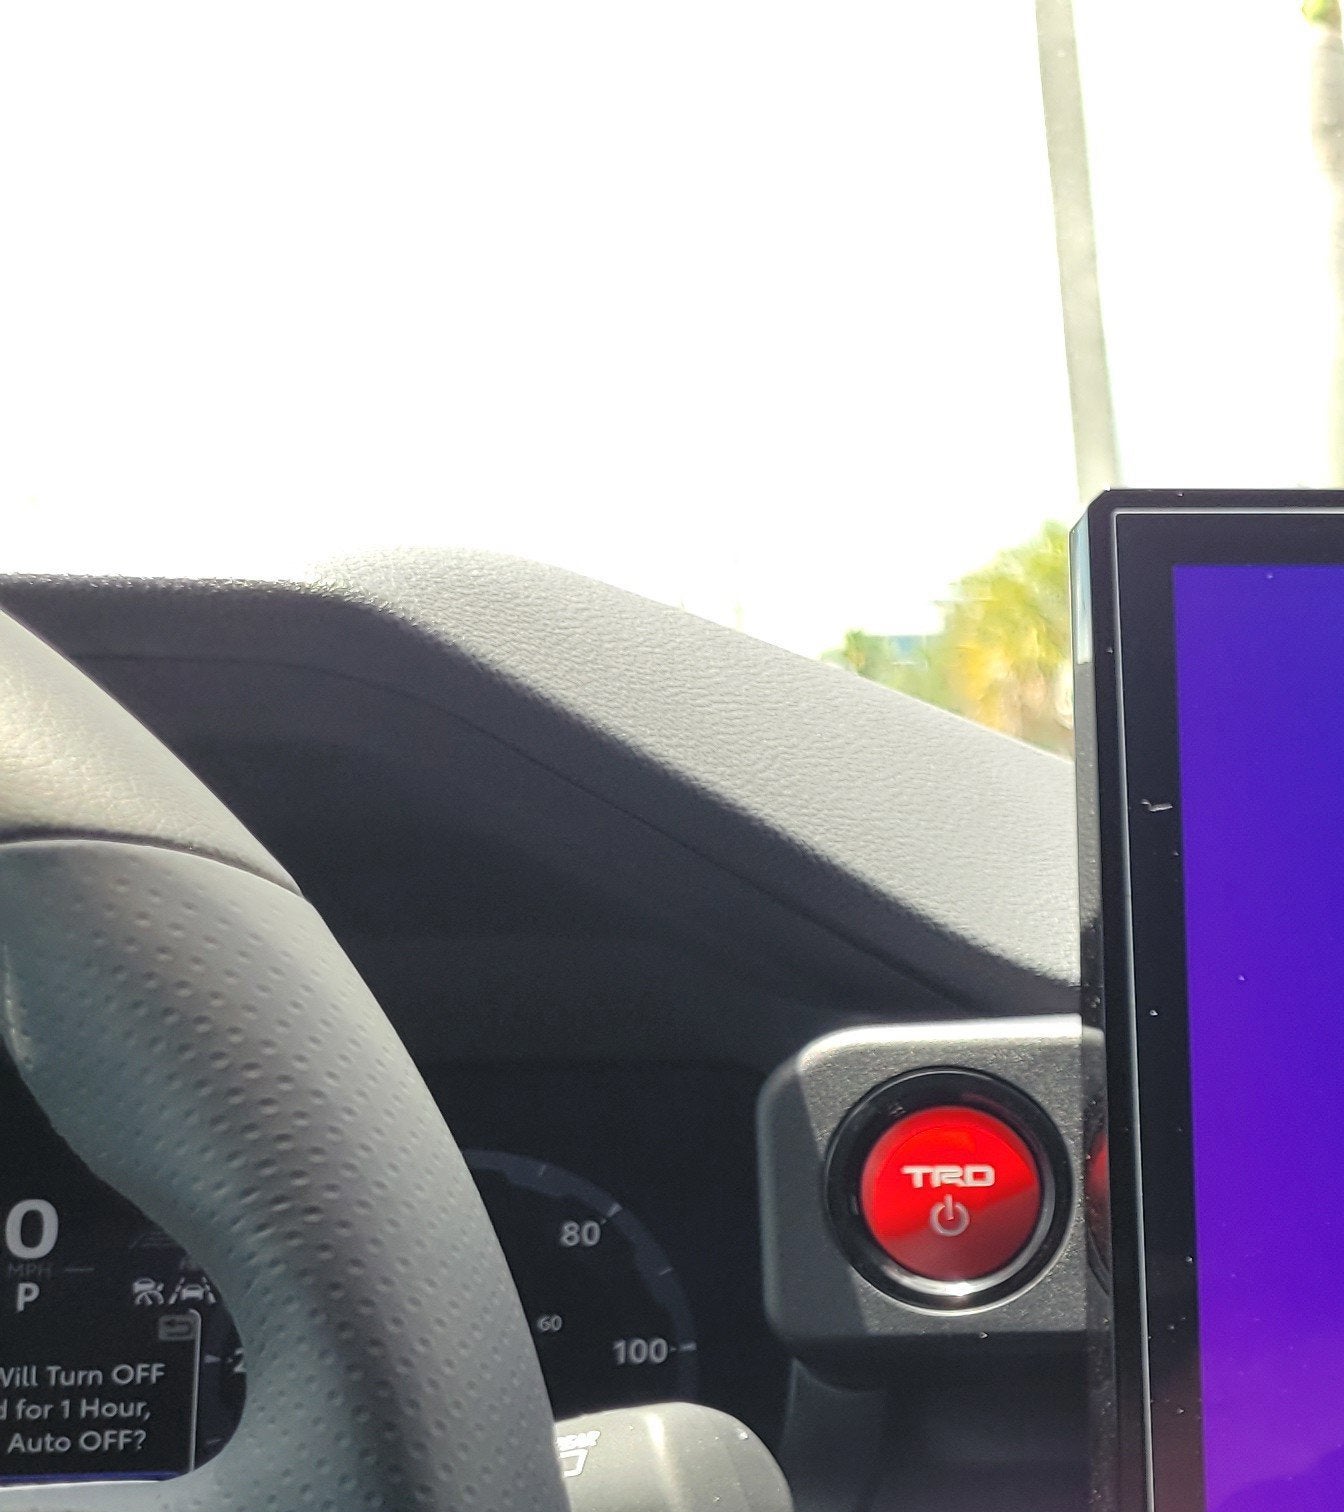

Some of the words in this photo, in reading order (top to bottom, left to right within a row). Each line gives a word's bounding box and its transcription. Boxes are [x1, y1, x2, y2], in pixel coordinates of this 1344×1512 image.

[901, 1164, 996, 1189] TRD
[5, 1199, 59, 1260] 0
[560, 1220, 601, 1247] 80
[16, 1282, 40, 1313] P
[537, 1315, 563, 1333] 60
[613, 1338, 669, 1365] 100
[46, 1365, 103, 1388] Turn
[111, 1363, 166, 1386] OFF
[17, 1399, 54, 1421] for
[60, 1400, 71, 1419] 1
[80, 1398, 151, 1421] Hour,
[8, 1432, 71, 1454] Auto
[79, 1429, 147, 1452] OFF?
